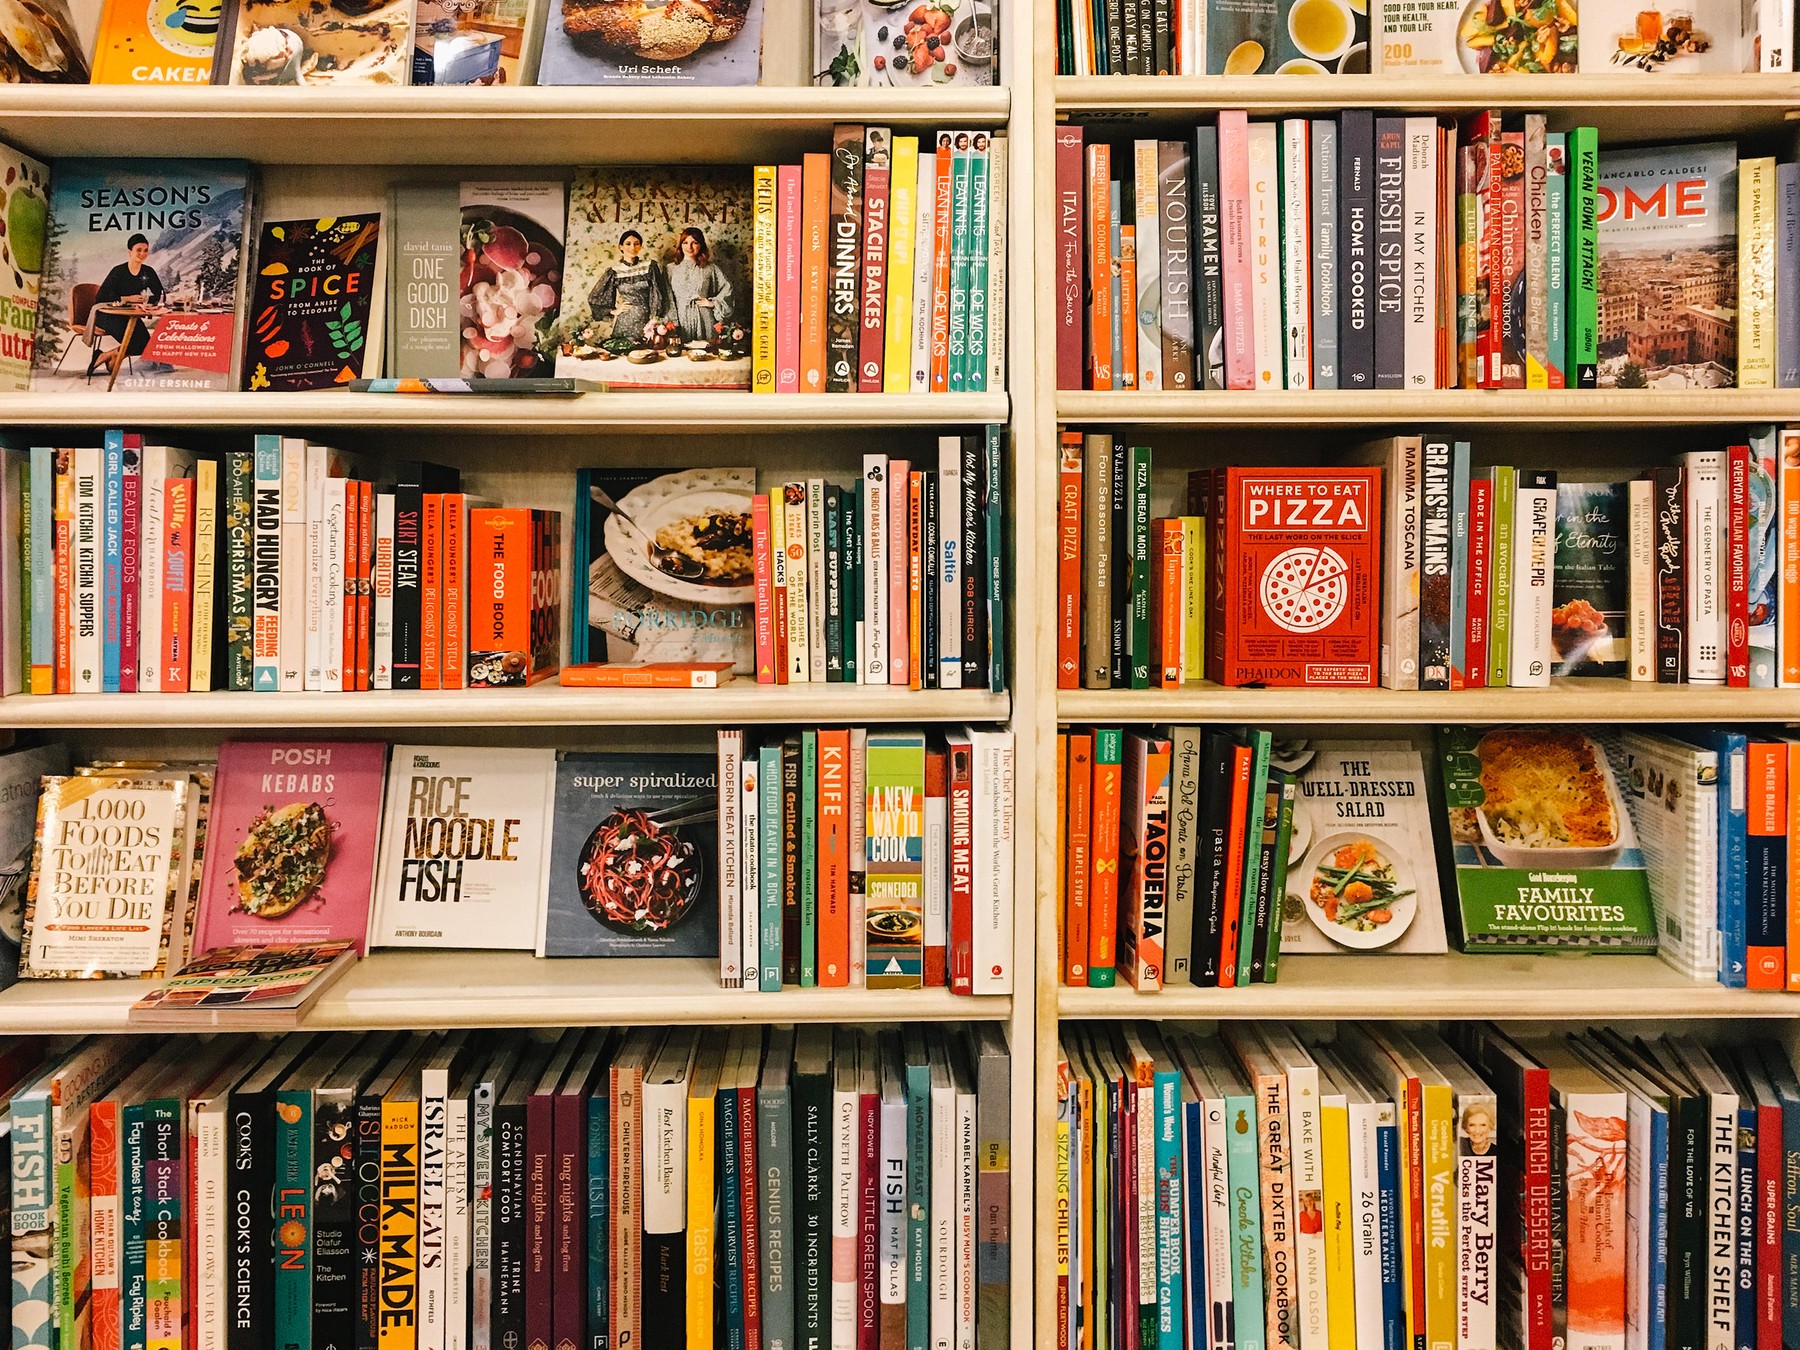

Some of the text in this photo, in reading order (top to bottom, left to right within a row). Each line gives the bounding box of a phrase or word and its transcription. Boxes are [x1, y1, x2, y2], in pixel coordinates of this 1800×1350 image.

[1383, 2, 1459, 12] GOOD FOR YOUR HEART,
[1384, 13, 1429, 22] YOUR HEALTH,
[1384, 23, 1433, 33] AND YOUR LIFE
[619, 65, 682, 74] Uri Scheft
[1385, 44, 1412, 59] 200
[80, 186, 211, 209] SEASON'S
[1063, 191, 1077, 236] ITALY
[1530, 166, 1546, 240] Chicken
[88, 209, 202, 233] EATINGS
[1379, 156, 1402, 313] FRESH SPICE
[1551, 192, 1560, 289] the PERFECT BLEND
[1581, 150, 1594, 291] VEGAN BOWL ATTACK!
[403, 242, 453, 251] david tanis
[865, 197, 885, 329] STACIE BAKES
[1165, 177, 1189, 320] NOURISH
[1203, 214, 1219, 276] RAMEN
[270, 273, 360, 300] SPICE
[298, 265, 322, 273] BOOK
[413, 258, 444, 280] ONE
[835, 223, 856, 316] DINNERS
[1351, 207, 1364, 330] HOME COOKED
[1414, 211, 1425, 323] IN MY KITCHEN
[407, 284, 449, 304] GOOD
[410, 309, 447, 329] DISH
[124, 377, 211, 389] GIZZI ERSKINE
[79, 475, 93, 497] TOM
[108, 441, 117, 556] A GIRL CALLED JACK
[1250, 485, 1361, 495] WHERE TO EAT
[1476, 489, 1484, 517] MADE
[1064, 485, 1078, 560] CRAFT PIZZA
[1249, 499, 1362, 525] PIZZA
[1405, 447, 1415, 570] MAMMA TOSCANA
[1476, 522, 1483, 532] IN
[1733, 460, 1743, 591] EVERYDAY ITALIAN FAVORITES
[232, 526, 245, 614] CHRISTMAS
[256, 489, 279, 612] MAD HUNGRY
[397, 511, 417, 588] SKIRT STEAK
[944, 540, 957, 583] Saltie
[493, 533, 504, 639] THE FOOD BOOK
[79, 593, 93, 637] SUPPERS
[1236, 667, 1301, 679] PHAIDON
[271, 748, 331, 765] POSH
[1340, 761, 1371, 776] THE
[1766, 753, 1775, 765] LA
[261, 774, 335, 793] KEBABS
[409, 776, 472, 818] RICE
[573, 773, 717, 791] super spiralized
[824, 746, 841, 816] KNIFE
[1302, 781, 1415, 797] WELL-DRESSED
[79, 798, 146, 821] 1,000
[725, 754, 735, 887] MODERN MEAT KITCHEN
[1337, 802, 1385, 817] SALAD
[1765, 794, 1775, 832] BRAZIER
[52, 848, 161, 872] TO EAT
[404, 818, 520, 861] NOODLE
[954, 789, 969, 893] SMOKING MEAT
[55, 872, 155, 896] BEFORE
[399, 860, 463, 902] FISH
[1143, 810, 1166, 939] TAQUERIA
[1518, 888, 1593, 904] FAMILY
[53, 897, 152, 920] YOU DIE
[1494, 905, 1625, 922] FAVOURITES
[13, 1114, 45, 1209] FISH
[501, 1122, 511, 1223] COMFORT FOOD
[990, 1143, 999, 1166] Brae
[422, 1096, 444, 1268] ISRAEL EATS
[1530, 1107, 1548, 1271] FRENCH DESSERTS
[767, 1167, 782, 1292] GENIUS RECIPES
[887, 1159, 903, 1297] FISH MAT FOLLAS
[1267, 1084, 1289, 1344] THE GREAT DIXTER COOKBOOK
[1362, 1192, 1374, 1256] 26 Grains
[1471, 1160, 1494, 1305] Mary Berry
[1713, 1114, 1732, 1331] THE KITCHEN SHELF
[238, 1189, 251, 1328] COOK'S SCIENCE
[381, 1143, 416, 1336] MILK.MADE.
